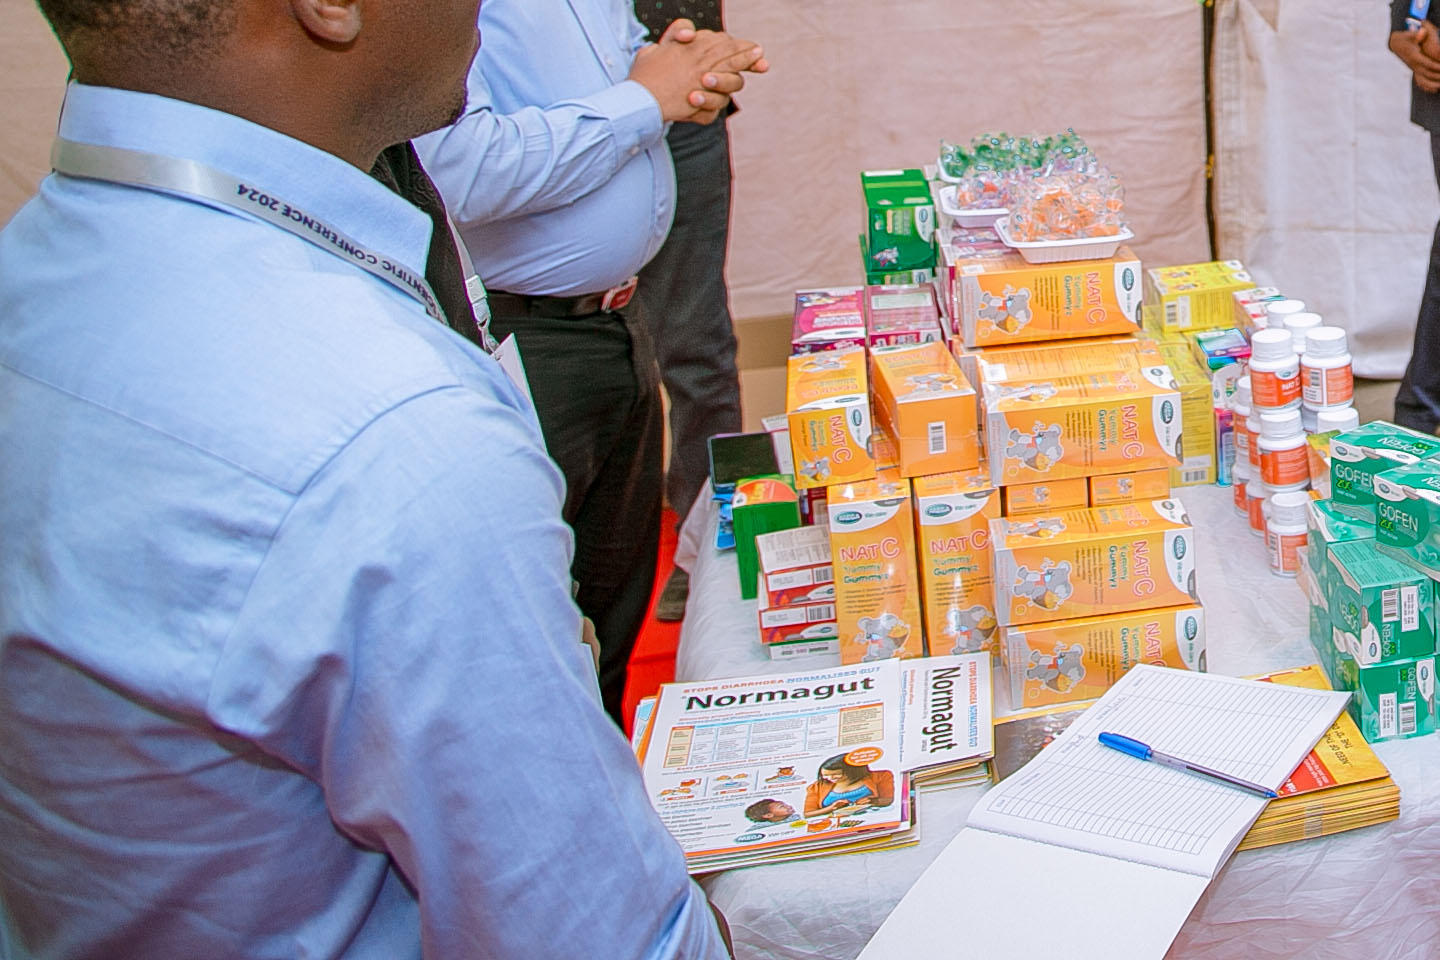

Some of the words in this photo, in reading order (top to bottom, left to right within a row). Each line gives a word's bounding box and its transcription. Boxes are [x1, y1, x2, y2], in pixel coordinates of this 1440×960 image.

[237, 184, 279, 211] 2024
[282, 204, 377, 265] CONFERENCE
[1086, 272, 1101, 305] NAT
[1087, 308, 1106, 324] C
[829, 415, 846, 447] NAT
[1122, 404, 1138, 441] NAT
[832, 448, 853, 464] C
[1122, 442, 1144, 459] C
[1378, 437, 1427, 454] GOFEN
[1379, 502, 1418, 532] GOFEN
[840, 544, 879, 562] NAT
[881, 537, 900, 559] C
[930, 536, 969, 554] NAT
[970, 529, 990, 550] C
[1119, 544, 1129, 581] Yummy
[1132, 540, 1150, 577] NAT
[1133, 579, 1156, 597] C
[1144, 622, 1162, 658] NAT
[1382, 624, 1391, 657] GOFEN
[685, 676, 876, 711] Normagut
[1408, 667, 1416, 700] GOFEN
[922, 666, 961, 753] Normagut
[737, 834, 763, 842] MEGA
